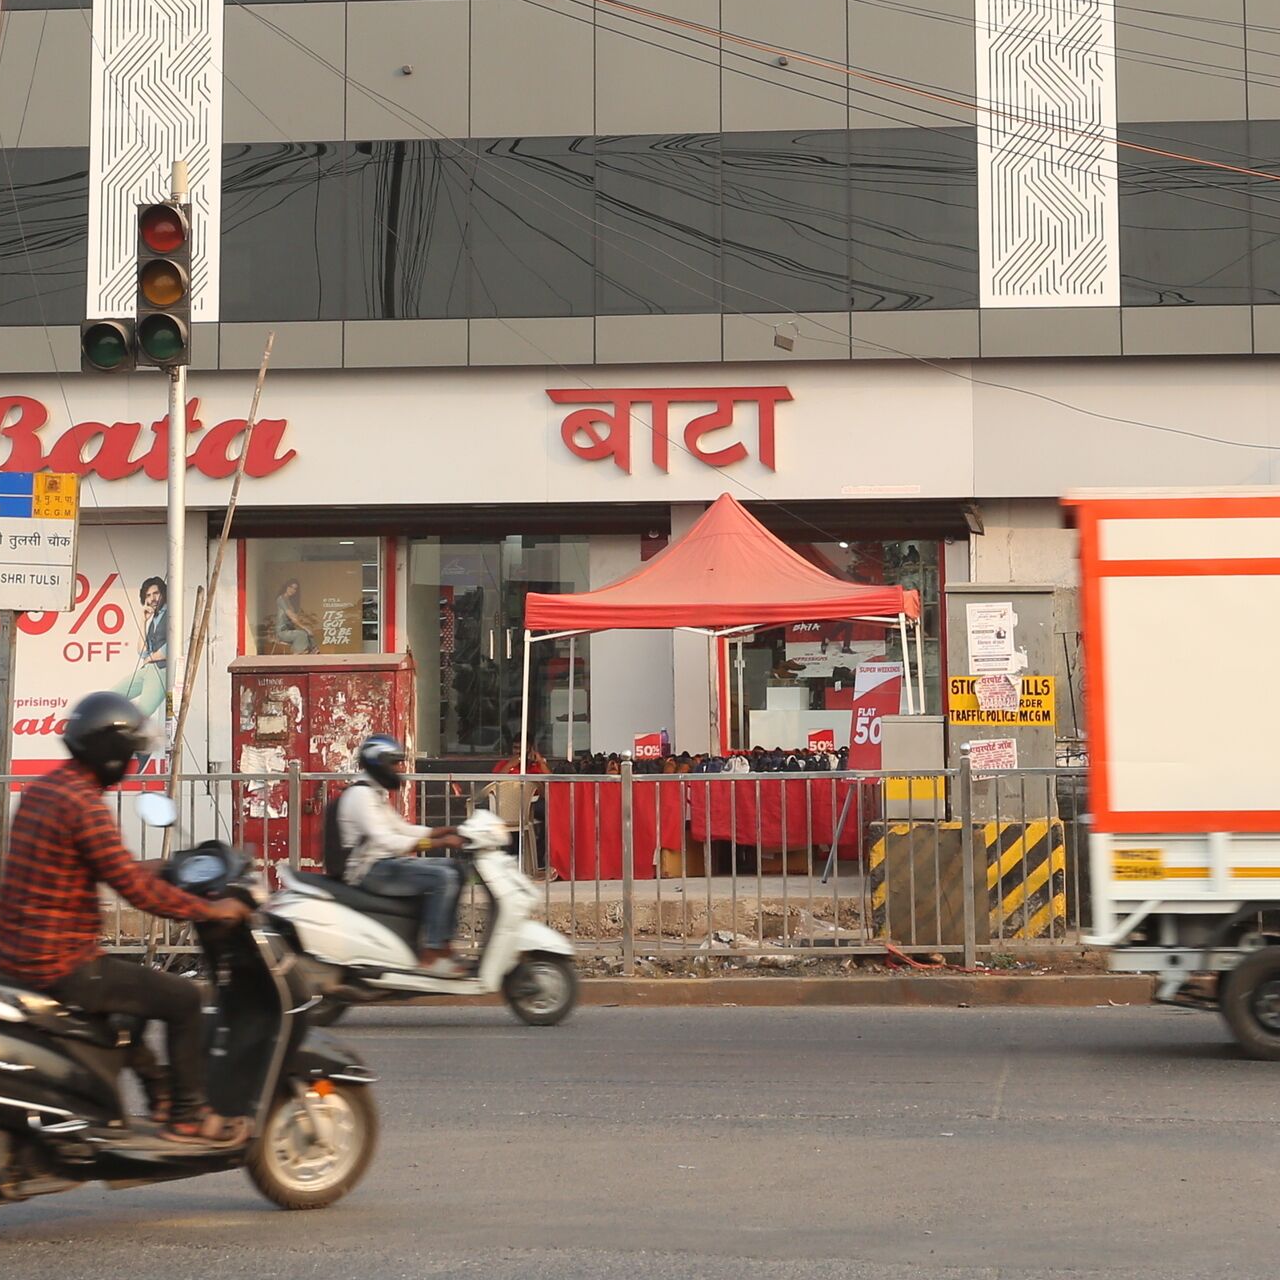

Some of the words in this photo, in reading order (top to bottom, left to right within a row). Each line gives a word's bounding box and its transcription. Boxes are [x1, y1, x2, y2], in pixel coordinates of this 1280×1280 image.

[545, 386, 794, 475] बाटा
[9, 532, 41, 550] तुलसी
[47, 533, 71, 547] चौक
[0, 573, 26, 584] SHRI
[29, 574, 60, 586] TULSI
[323, 619, 346, 628] GOT
[323, 628, 336, 636] TO
[338, 628, 352, 636] BE
[322, 636, 351, 644] BATA
[1021, 679, 1050, 696] ILLS
[14, 698, 68, 708] rprisingly
[1020, 699, 1043, 708] RDER
[858, 708, 876, 716] FLAT
[950, 710, 985, 722] TRAFFIC
[636, 745, 660, 757] 50%
[809, 740, 834, 751] 50%
